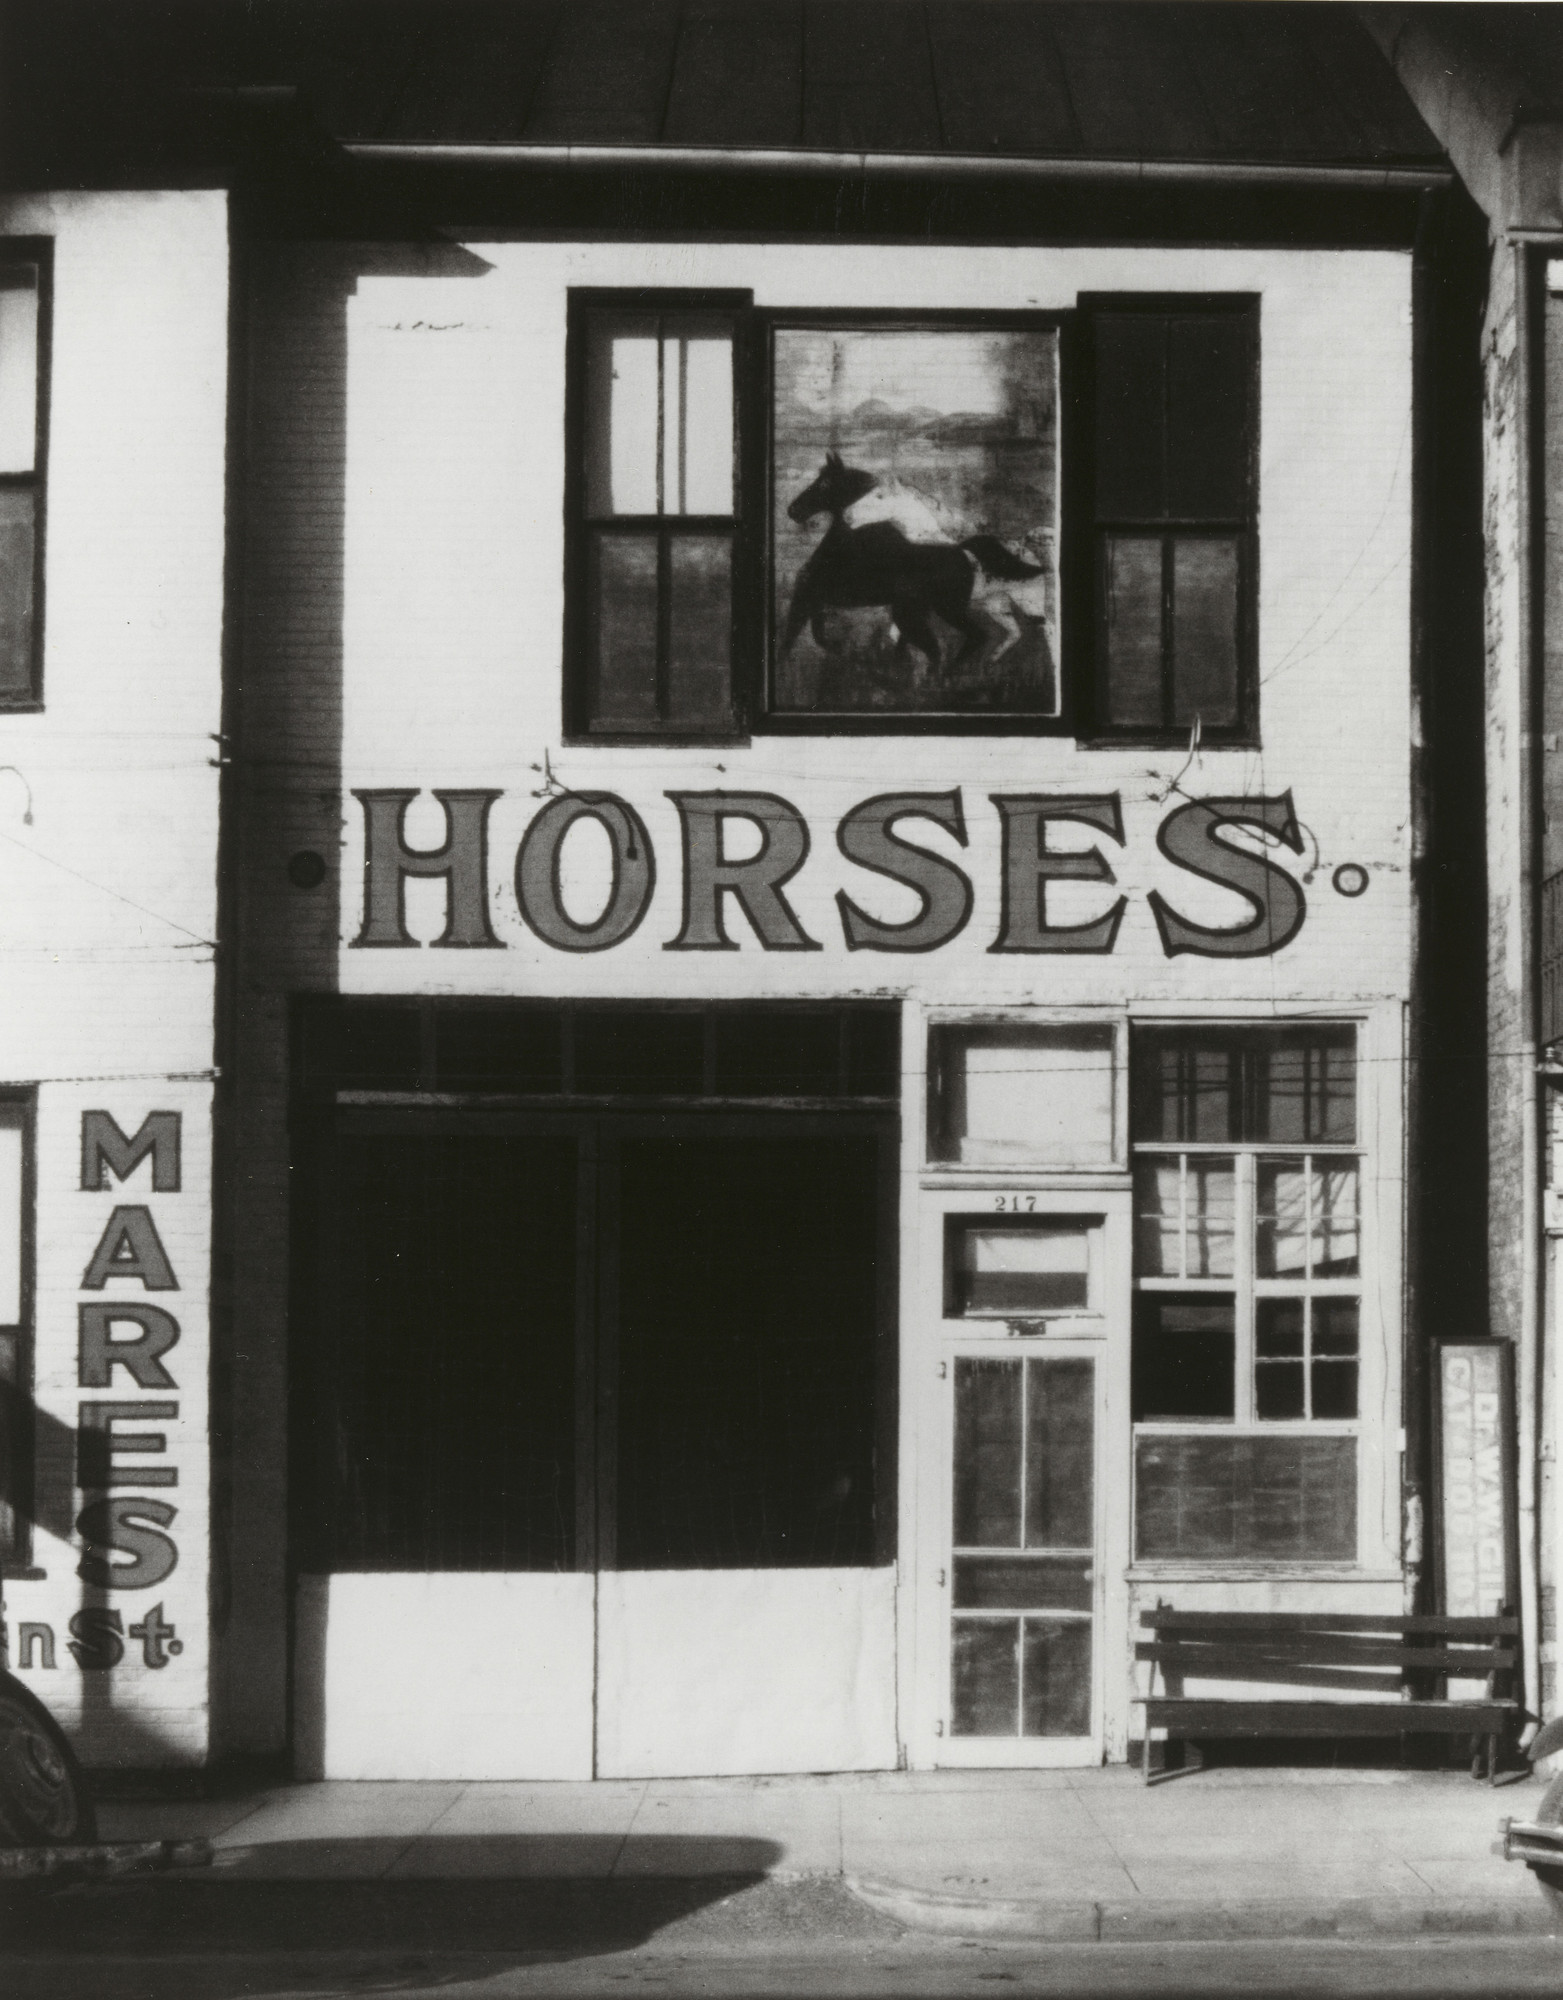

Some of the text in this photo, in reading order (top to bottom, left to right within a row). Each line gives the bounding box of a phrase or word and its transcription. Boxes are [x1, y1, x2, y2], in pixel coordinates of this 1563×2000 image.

[349, 788, 1306, 958] HORSES
[994, 1195, 1037, 1212] 217
[75, 1109, 182, 1591] MARES
[66, 1601, 184, 1670] St.
